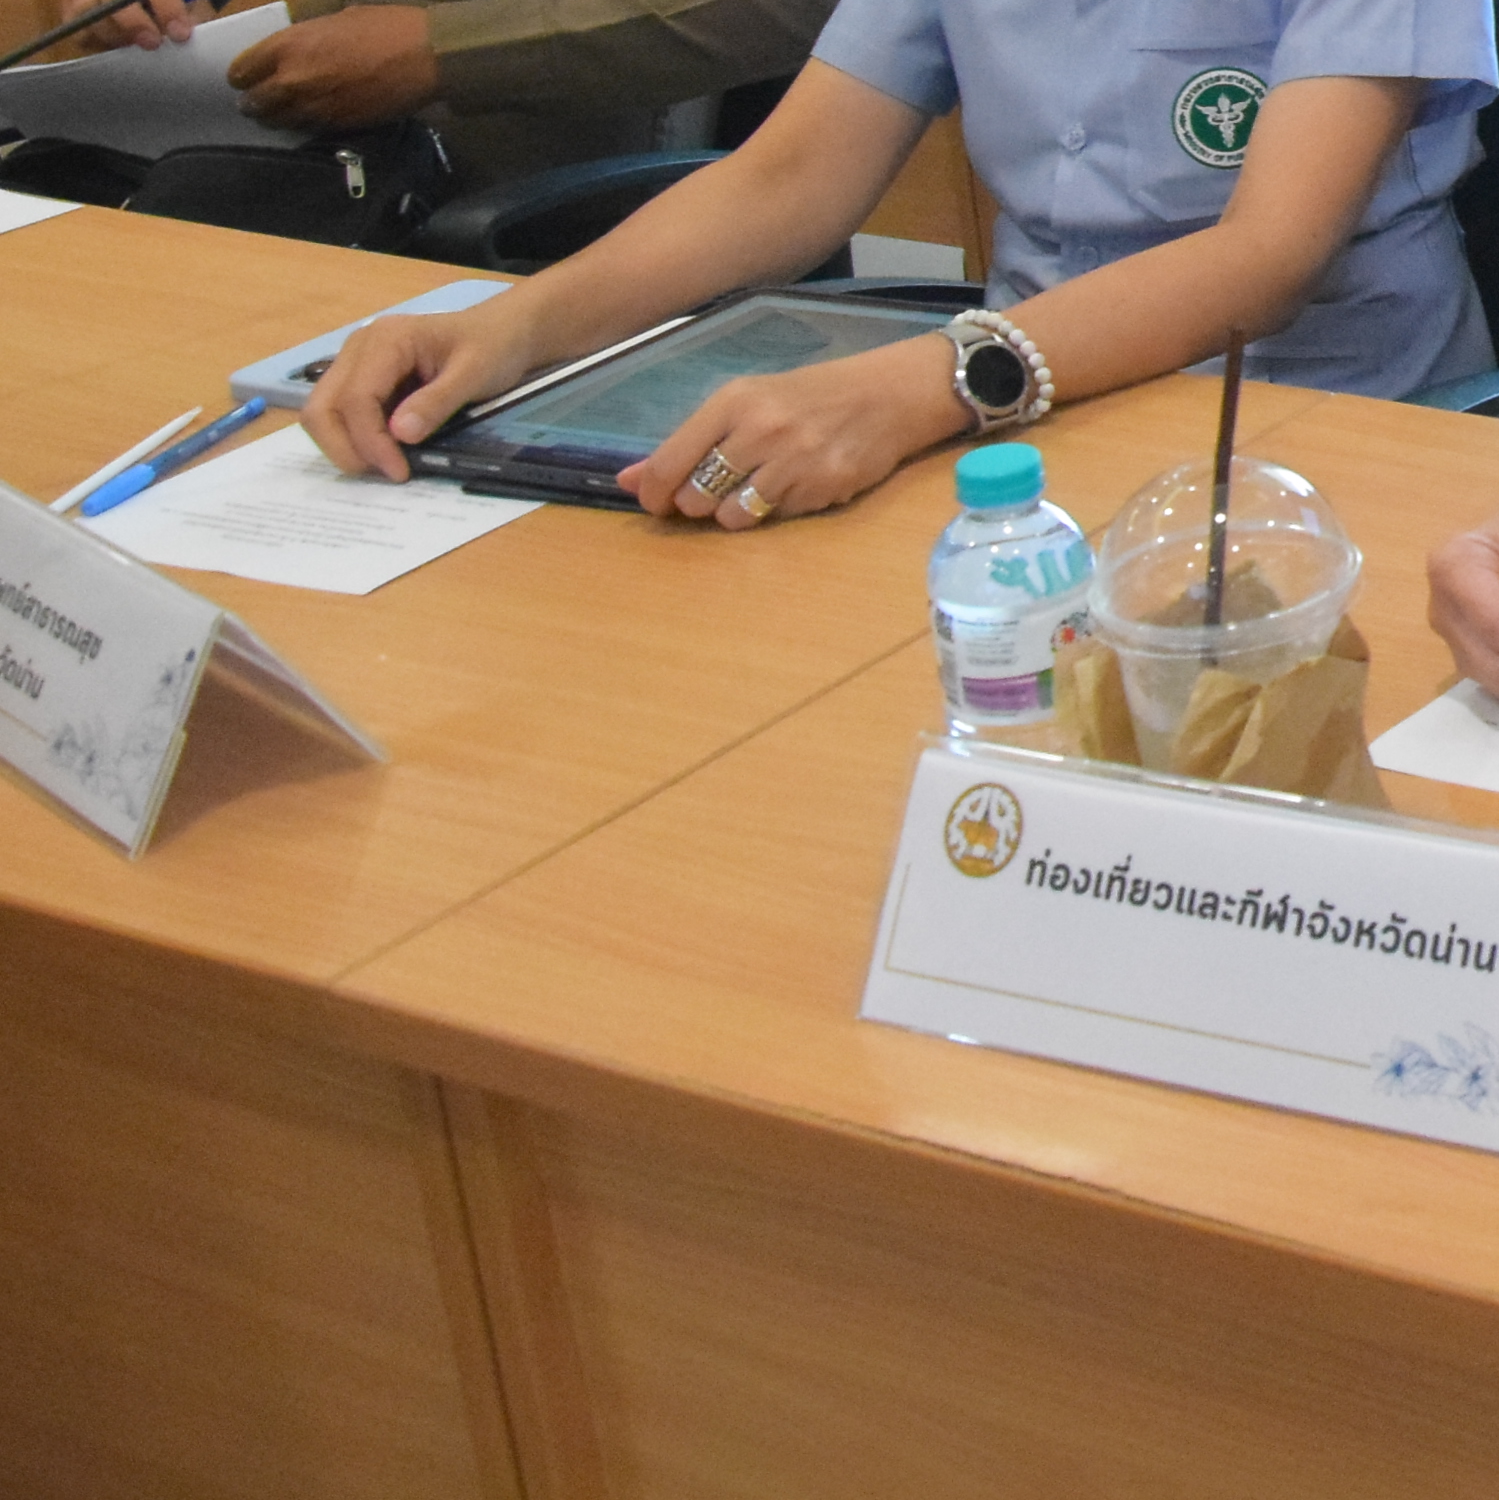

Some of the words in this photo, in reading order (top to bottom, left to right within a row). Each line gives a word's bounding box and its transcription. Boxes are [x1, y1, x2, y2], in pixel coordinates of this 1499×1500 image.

[1026, 849, 1498, 973] ท่องเที่ยวและกีฬาจังหวัดน่าน
